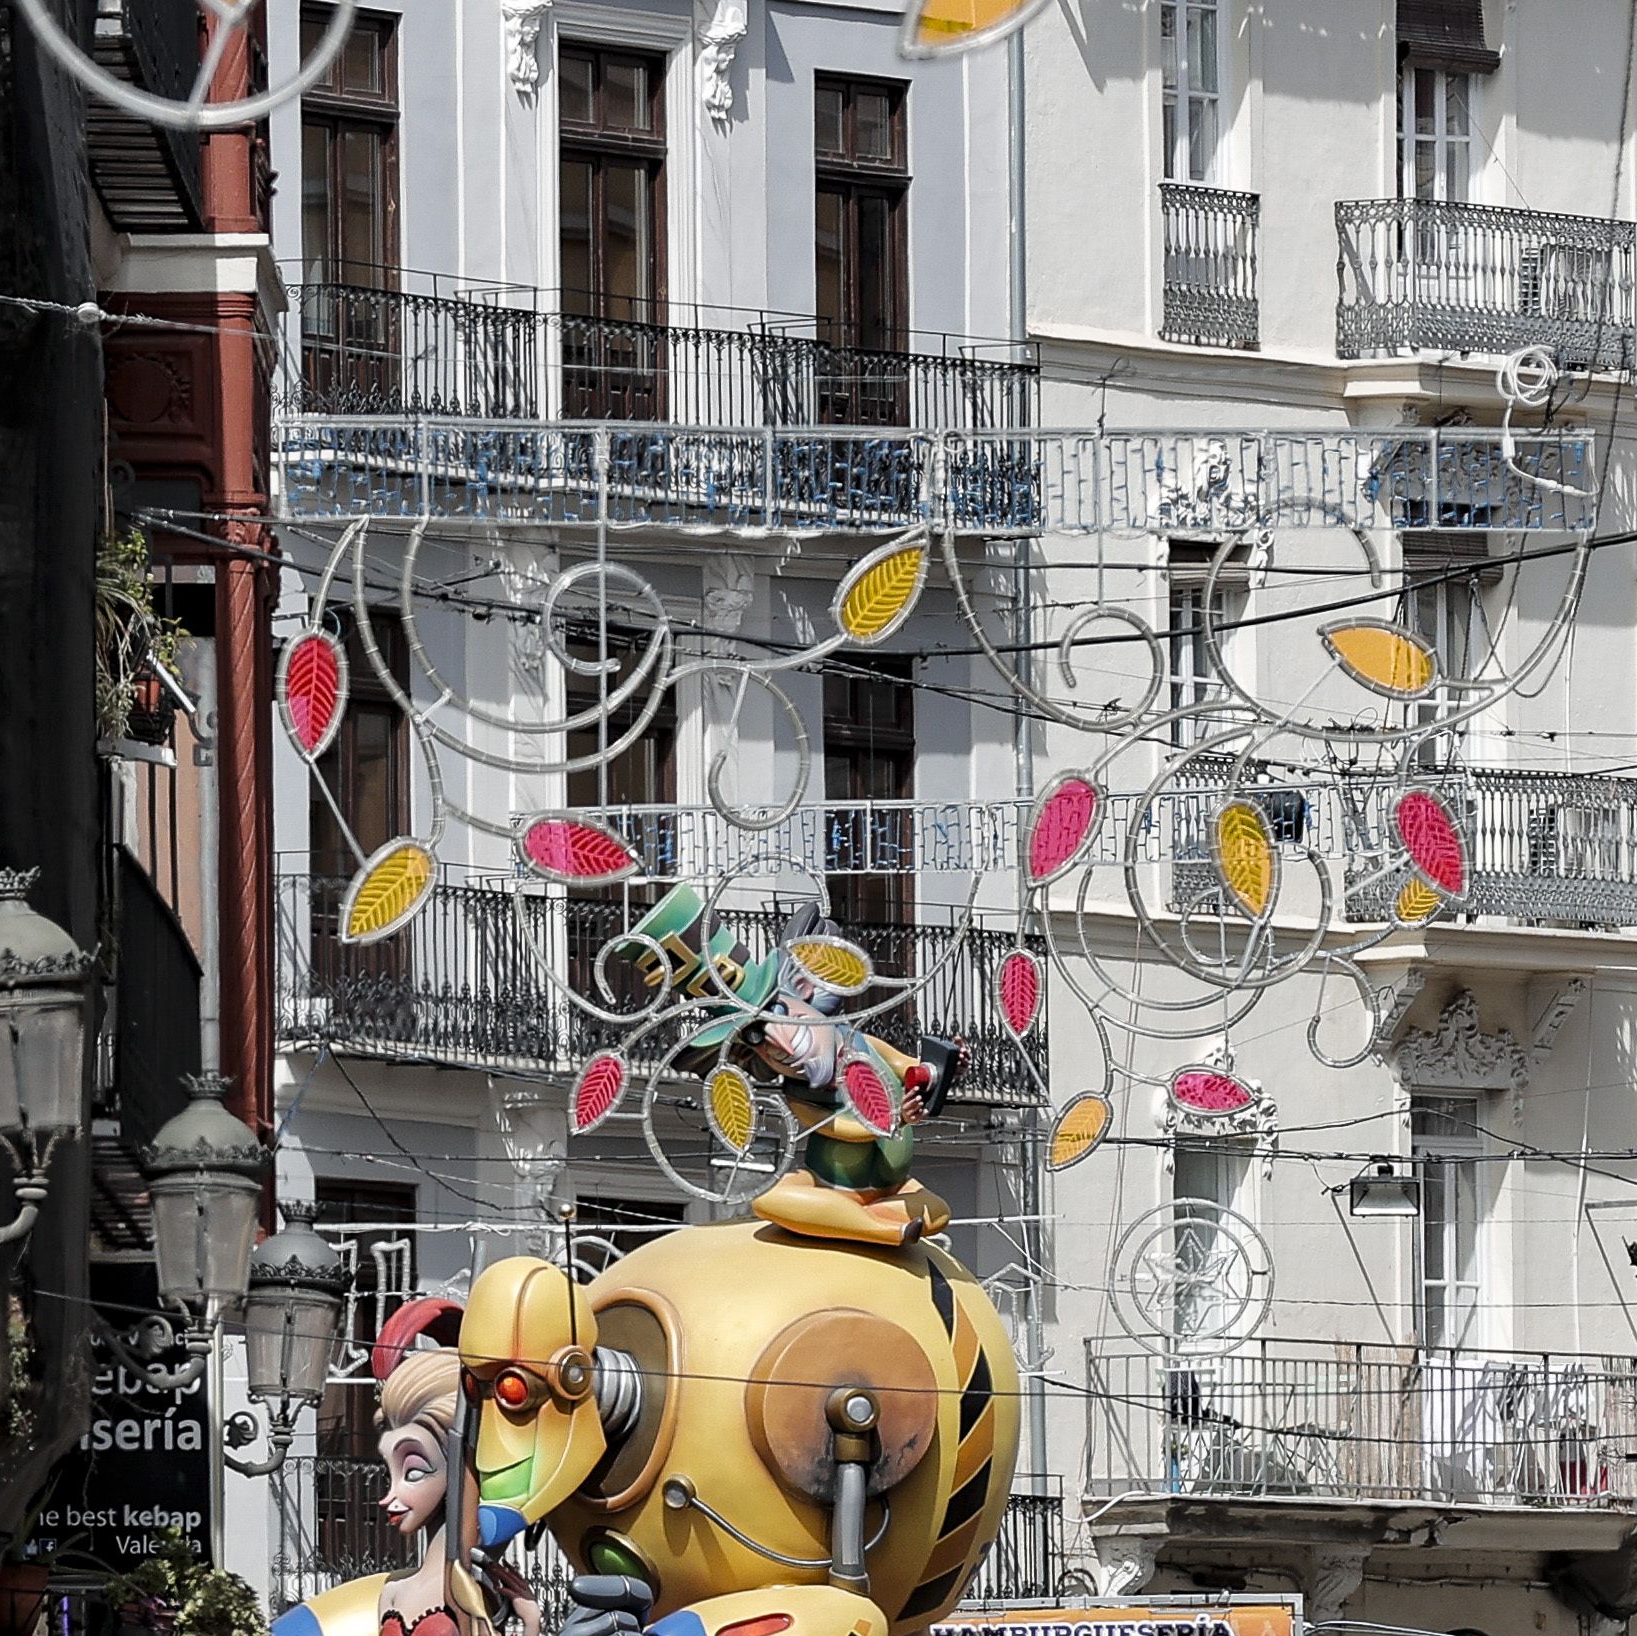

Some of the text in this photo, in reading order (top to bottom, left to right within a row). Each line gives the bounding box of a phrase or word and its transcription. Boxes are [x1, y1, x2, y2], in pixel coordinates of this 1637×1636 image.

[67, 1503, 116, 1527] best
[123, 1503, 202, 1533] kebap
[115, 1534, 202, 1554] Valea
